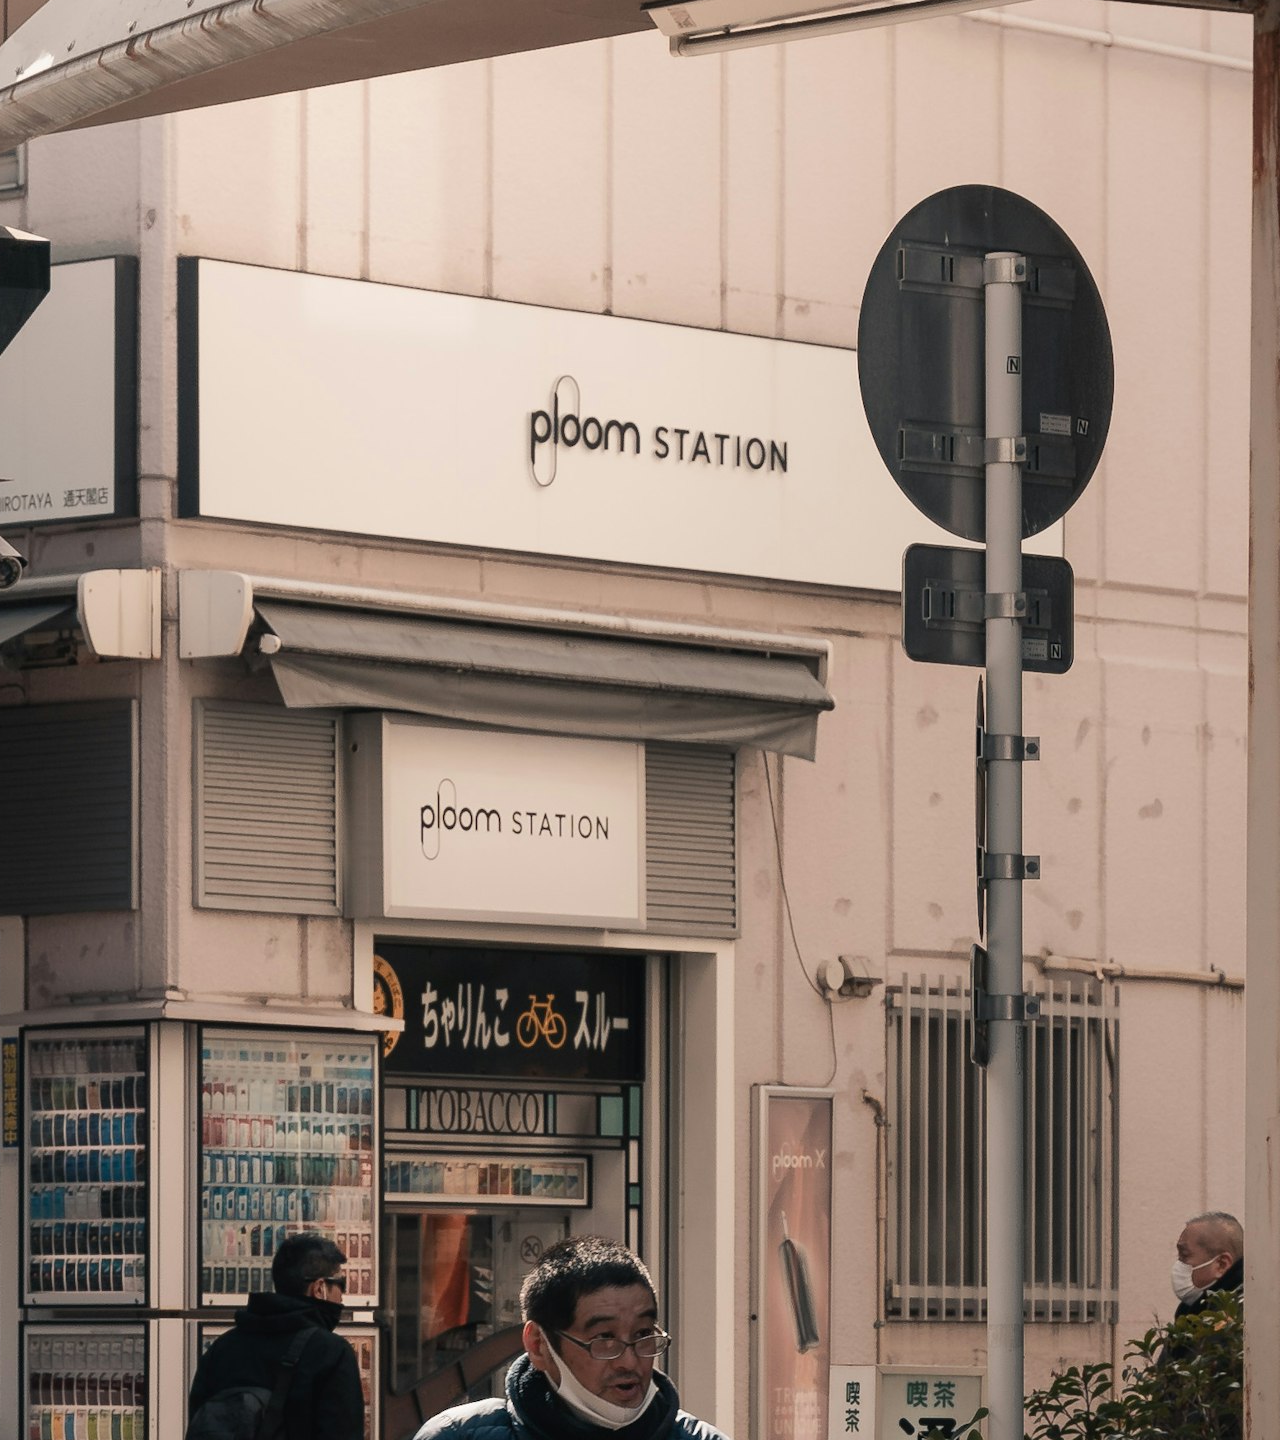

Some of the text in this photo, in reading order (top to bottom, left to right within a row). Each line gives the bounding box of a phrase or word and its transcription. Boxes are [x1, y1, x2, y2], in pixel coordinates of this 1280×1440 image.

[528, 375, 789, 488] ploom STATION
[420, 778, 610, 861] ploom STATION
[420, 980, 630, 1053] ちゃりんこ スルー
[419, 1090, 540, 1134] TOBACCO
[772, 1142, 826, 1182] ploom X
[845, 1381, 861, 1433] 喫茶
[906, 1380, 957, 1409] 喫茶
